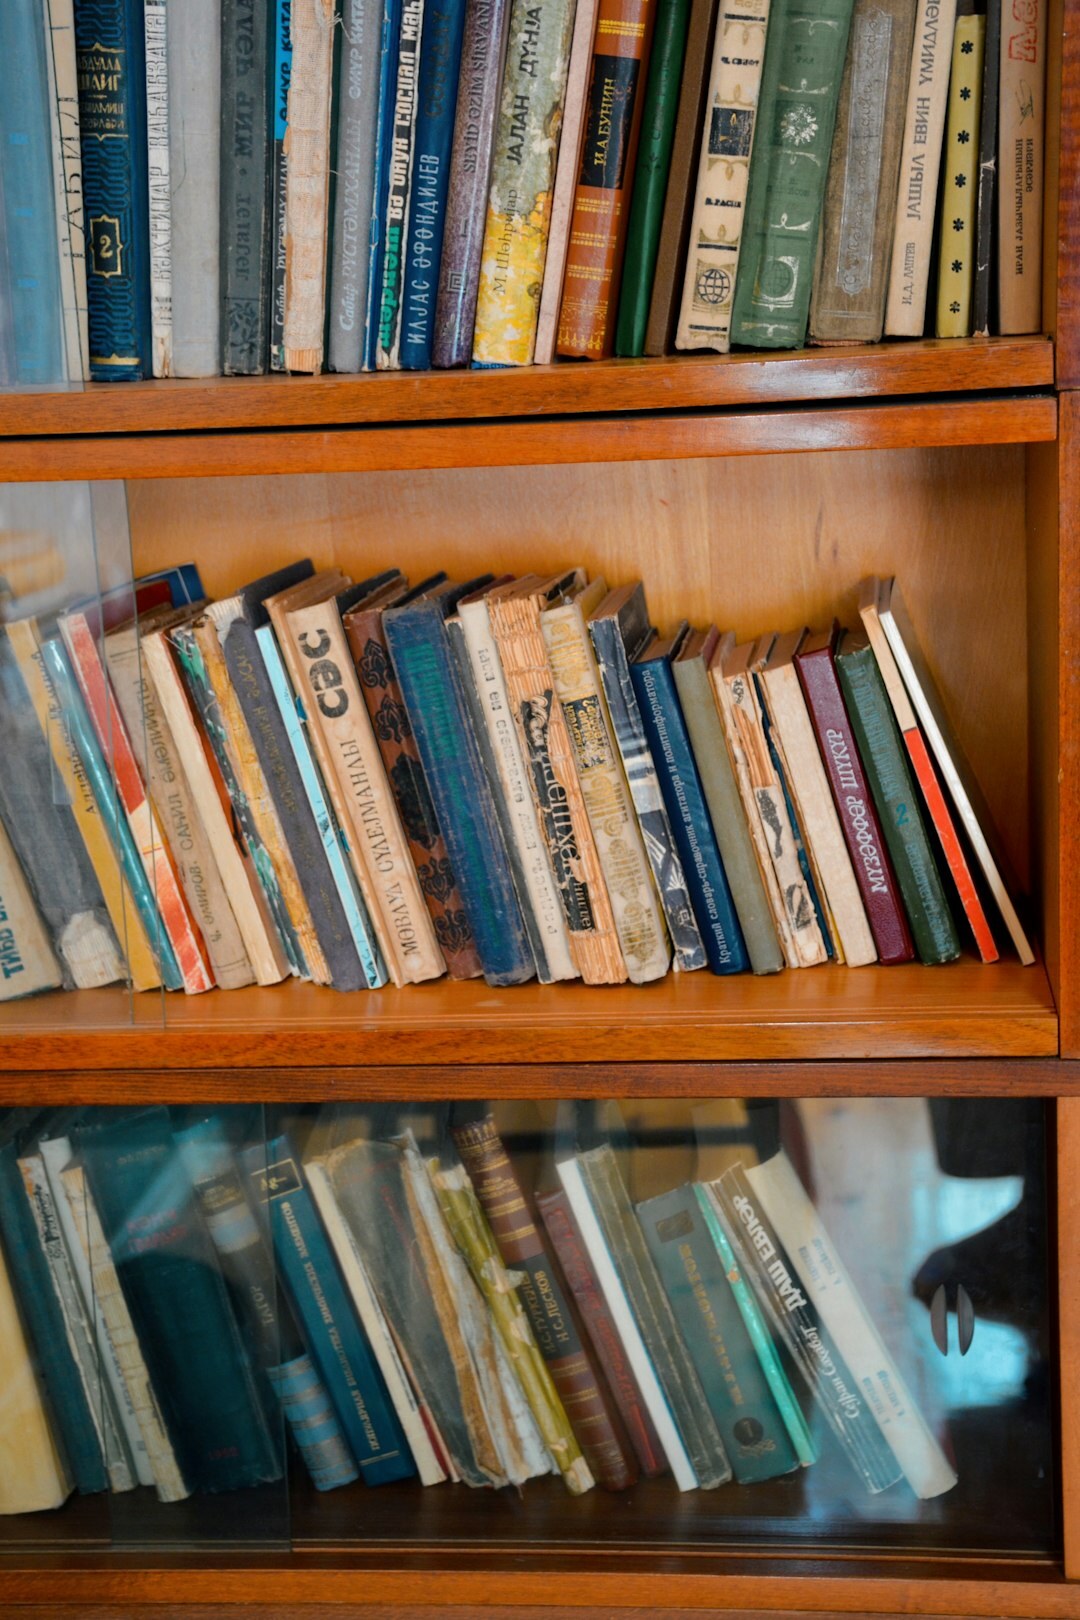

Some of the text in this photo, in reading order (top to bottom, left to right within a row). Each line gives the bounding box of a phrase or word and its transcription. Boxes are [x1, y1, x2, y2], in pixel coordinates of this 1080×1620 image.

[505, 92, 530, 165] ЈАЛАН
[913, 96, 930, 145] ЕВИН
[1025, 138, 1034, 192] ӘСӘРЛӘРИ
[905, 152, 926, 220] ЈАШЫЛ
[1014, 138, 1023, 274] ИРАН ЈАЗЫЧЫЛАРЫНЫН
[100, 236, 112, 258] 2
[406, 154, 441, 344] ИЛЈАС ӘФӘНДИЈЕВ
[296, 625, 352, 721] СӘС
[638, 668, 732, 964] Краткий словарь-справочник агитатора и политинформатора
[824, 725, 889, 896] МҮЗӘФФӘР ШҮКҮР
[728, 1190, 808, 1313] ДАШ ЕВЛӘР
